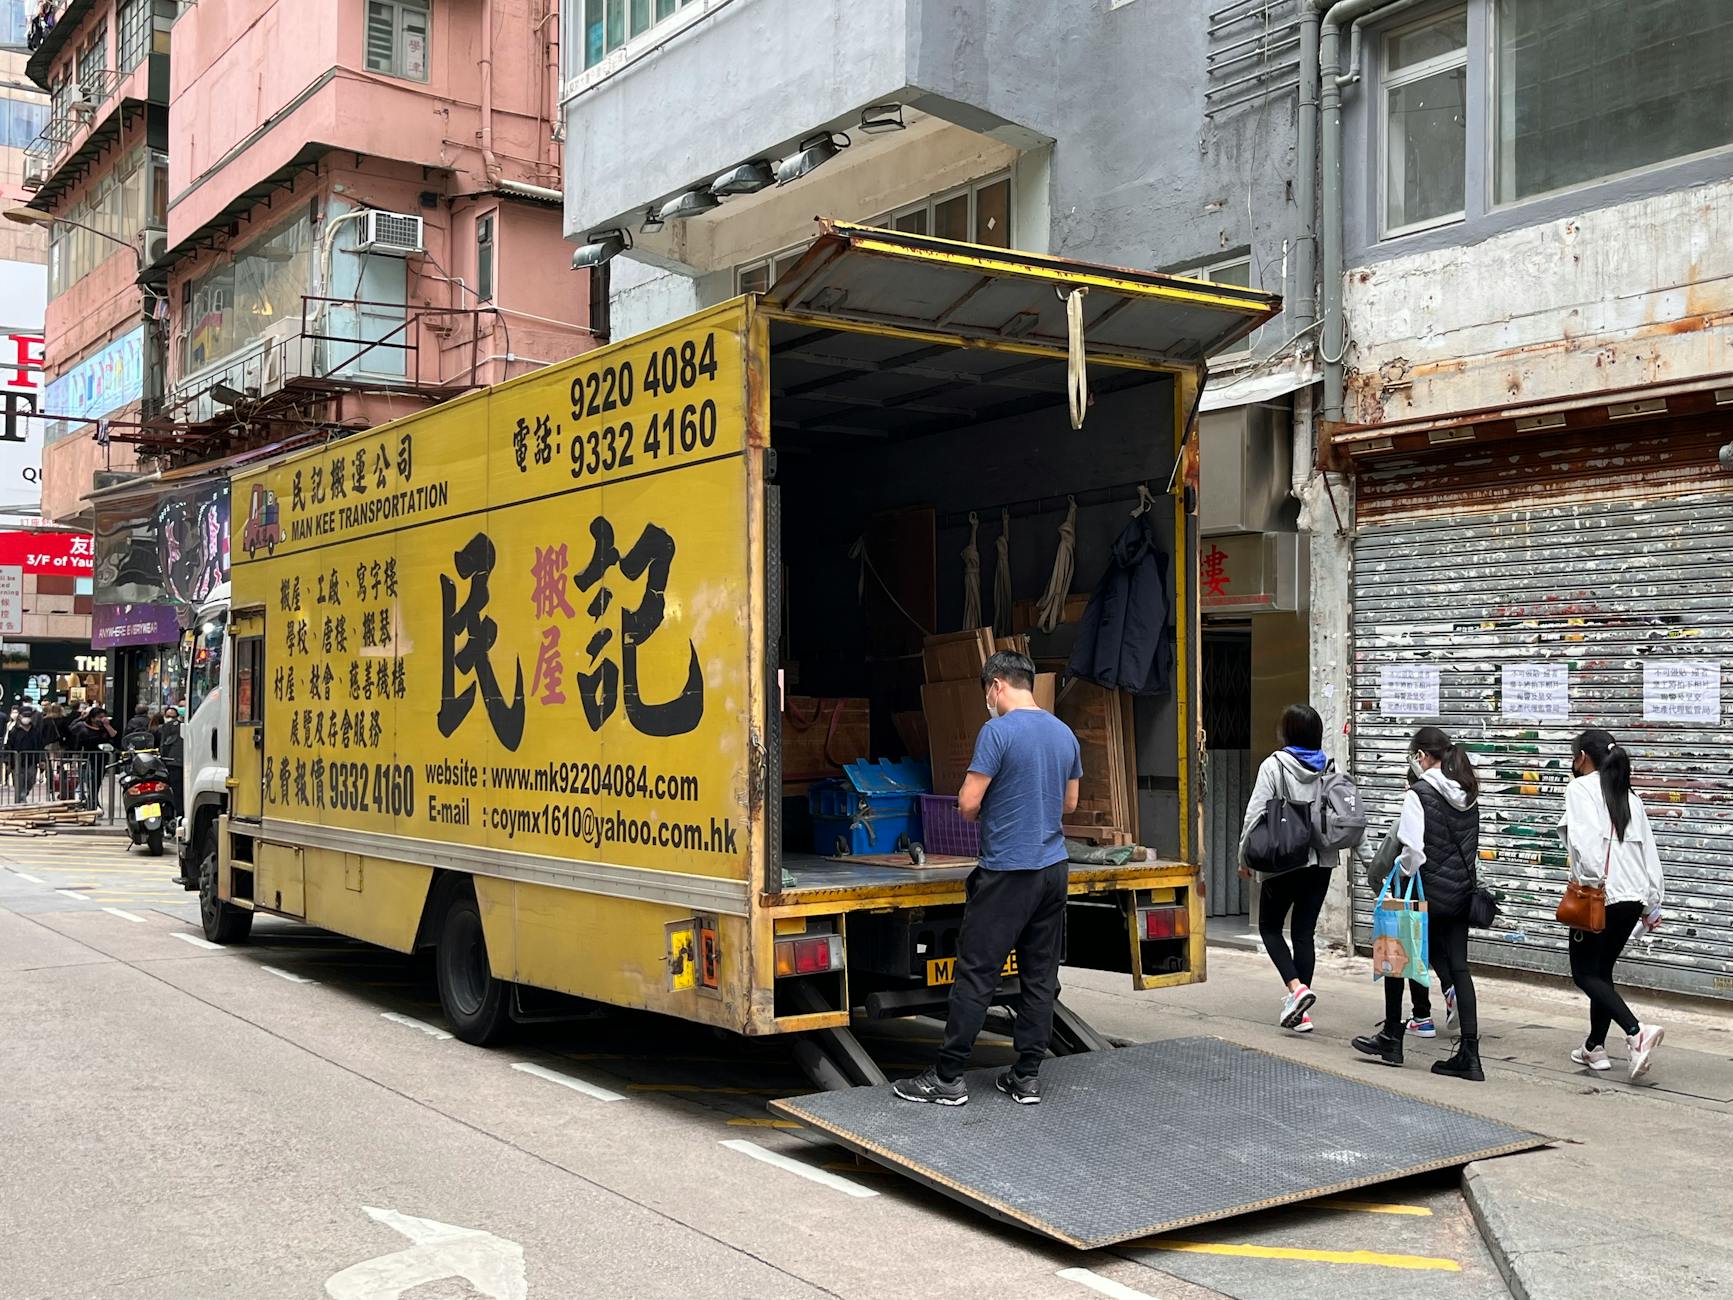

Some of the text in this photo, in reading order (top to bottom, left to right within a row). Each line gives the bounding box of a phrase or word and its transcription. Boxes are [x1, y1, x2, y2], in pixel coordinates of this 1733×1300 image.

[570, 332, 718, 421] 9220 4084
[570, 398, 717, 479] 9332 4160
[22, 467, 43, 483] Q
[291, 433, 413, 513] 民記搬運公司
[291, 516, 313, 542] MAN
[315, 511, 336, 535] KEE
[338, 480, 449, 530] TRANSPORTATION
[26, 554, 94, 568] 3/F of Yau
[530, 542, 576, 706] 搬屋
[74, 655, 107, 672] THE
[329, 761, 369, 812] 9332
[372, 763, 415, 818] 4160
[491, 762, 699, 802] www.mk92204084.com
[428, 795, 470, 826] E-mail
[491, 804, 738, 855] coymx1610@yahoo.com.hk
